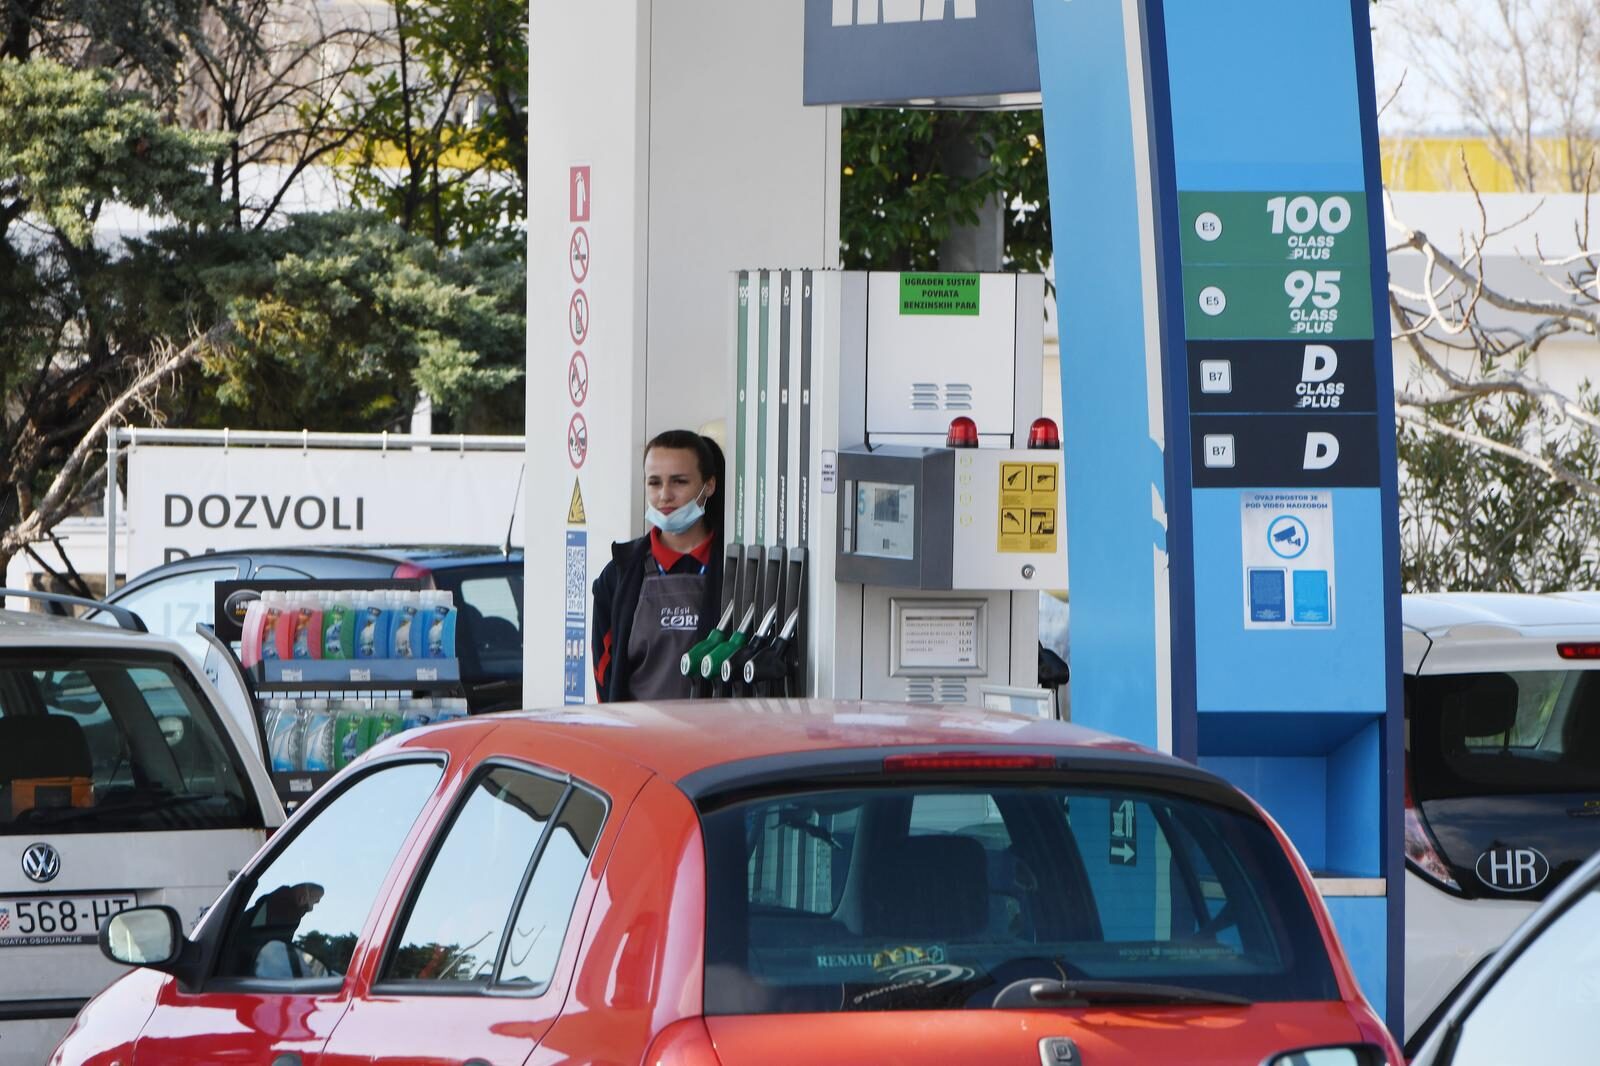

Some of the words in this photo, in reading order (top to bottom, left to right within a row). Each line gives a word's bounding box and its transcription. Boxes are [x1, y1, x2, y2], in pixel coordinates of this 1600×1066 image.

[1266, 195, 1351, 234] 100
[1202, 222, 1215, 231] E5
[1287, 235, 1335, 247] CLASS
[1293, 248, 1330, 260] PLUS
[946, 277, 977, 286] SUSTAV
[804, 285, 811, 298] D
[921, 289, 960, 298] POVRATA
[1284, 270, 1341, 309] 95
[903, 300, 953, 309] BENZINSKIH
[955, 301, 977, 309] PARA
[1206, 297, 1219, 306] E5
[1290, 309, 1338, 321] CLASS
[1295, 322, 1333, 334] PLUS
[1301, 344, 1338, 382] D
[1209, 372, 1223, 381] B7
[1295, 383, 1345, 395] CLASS
[1301, 395, 1340, 408] PLUS
[1212, 446, 1226, 456] B7
[1303, 431, 1340, 470] D
[164, 494, 364, 531] DOZVOLI
[1490, 849, 1537, 885] HR
